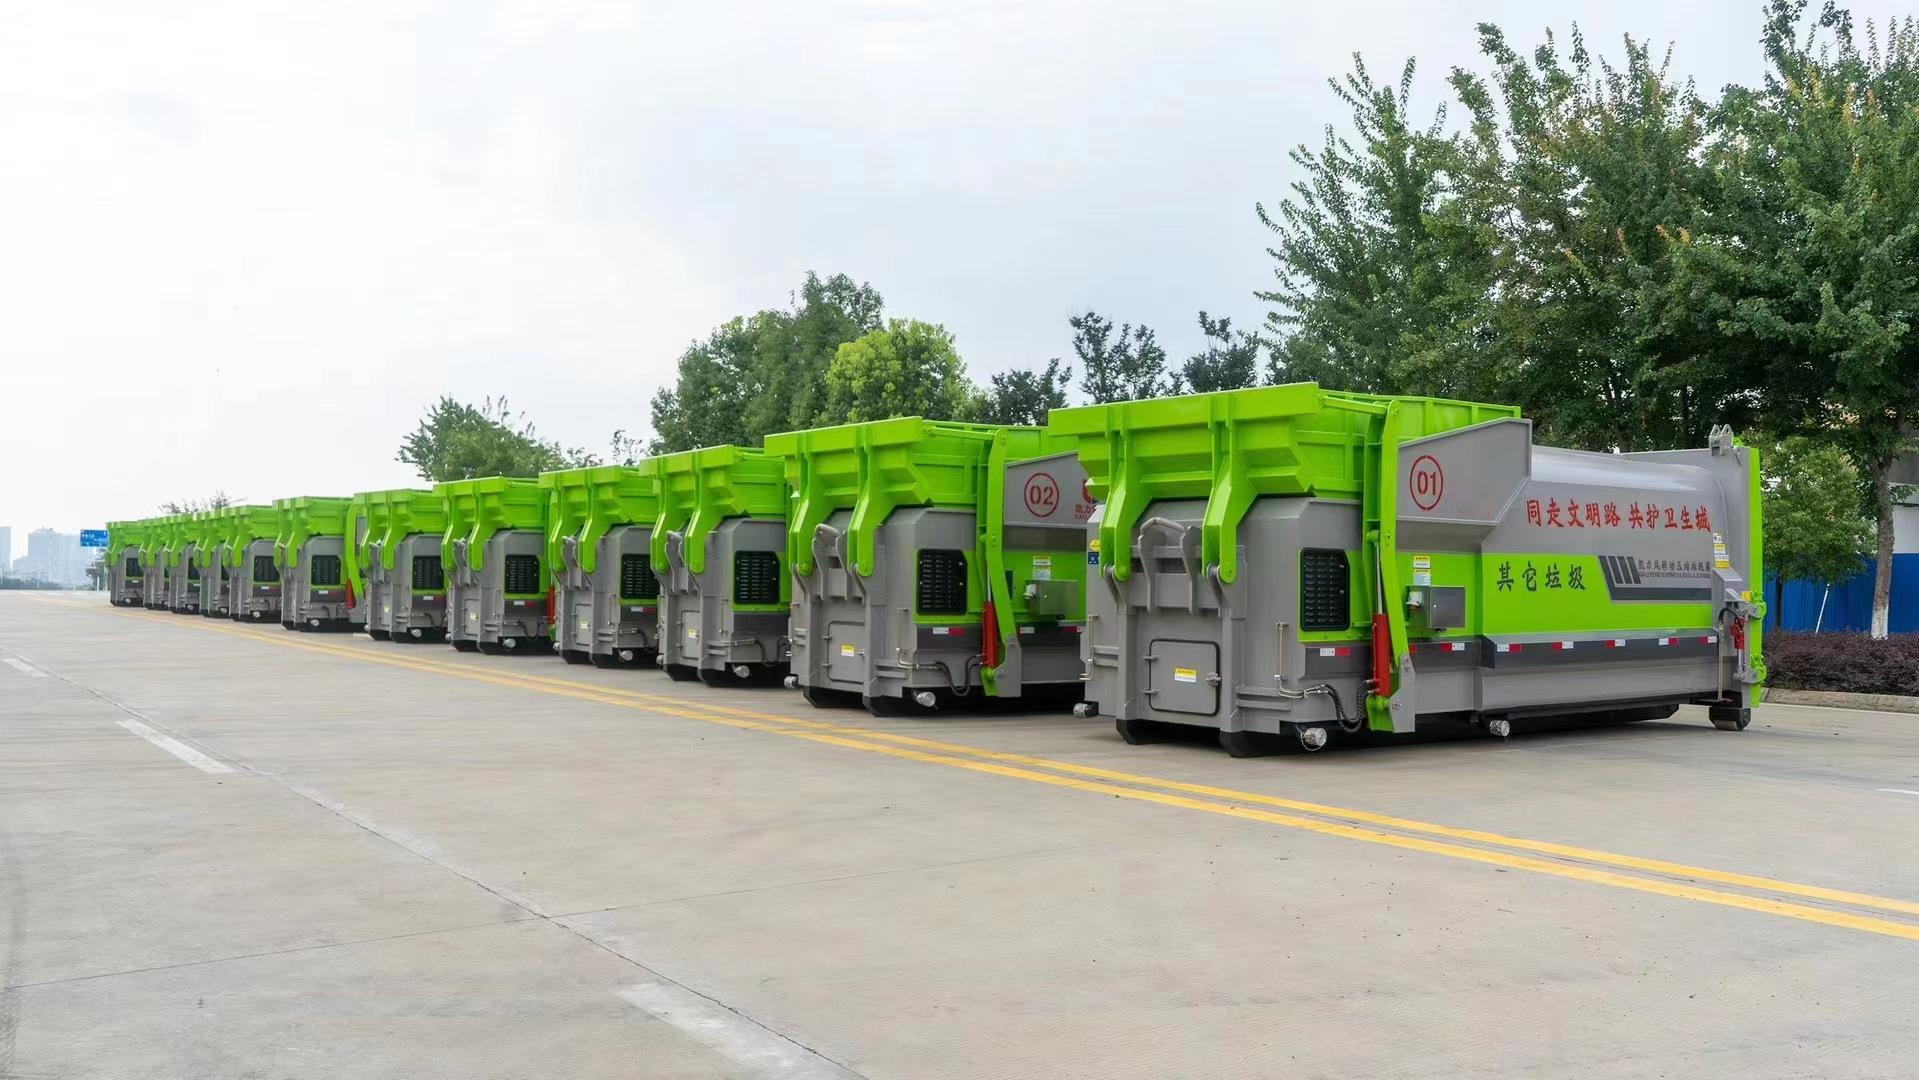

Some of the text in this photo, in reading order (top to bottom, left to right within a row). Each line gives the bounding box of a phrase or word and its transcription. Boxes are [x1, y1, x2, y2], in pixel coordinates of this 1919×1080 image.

[1030, 485, 1054, 505] 02
[1417, 470, 1437, 496] 01
[1526, 497, 1711, 532] 同走文明路 共护卫生城
[1496, 560, 1586, 592] 其它垃圾
